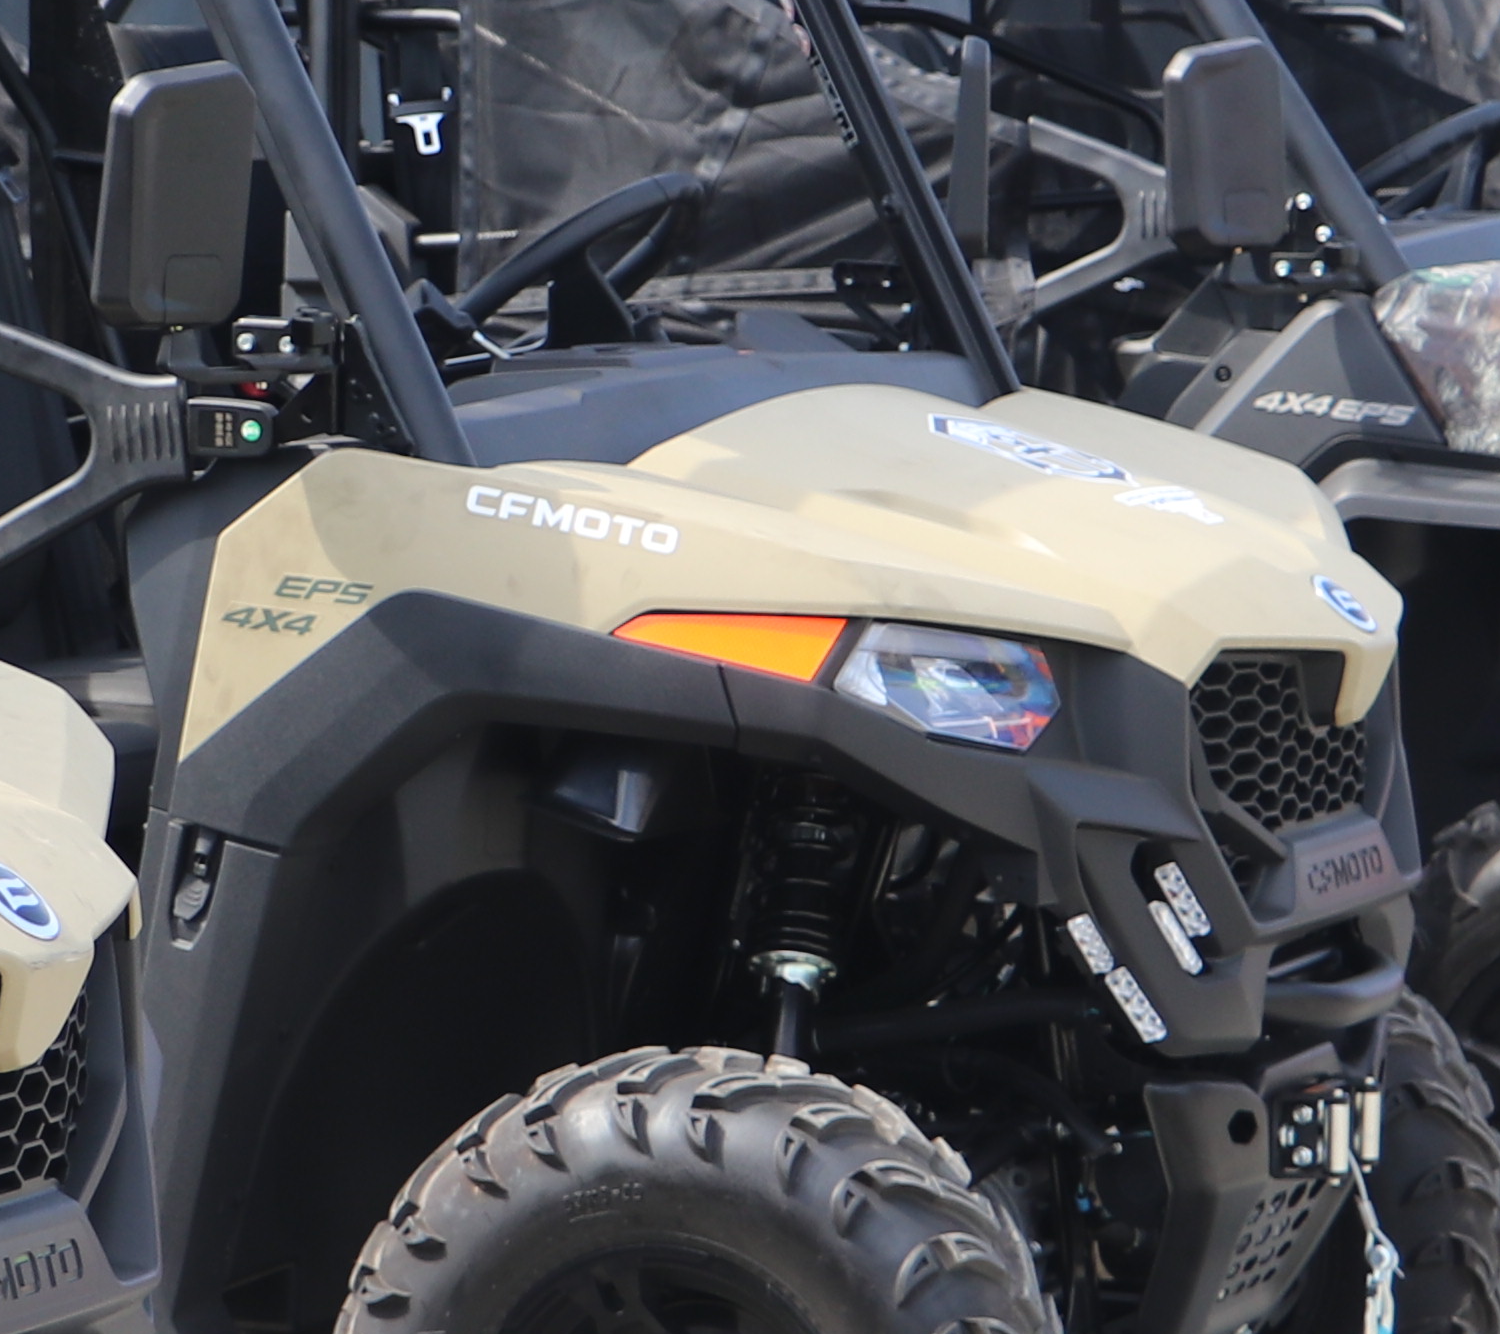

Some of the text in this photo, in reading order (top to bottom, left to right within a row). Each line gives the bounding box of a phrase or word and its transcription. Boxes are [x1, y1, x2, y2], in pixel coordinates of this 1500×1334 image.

[465, 484, 680, 555] CFMOTO
[274, 575, 374, 605] EPS
[221, 606, 318, 637] 4X4
